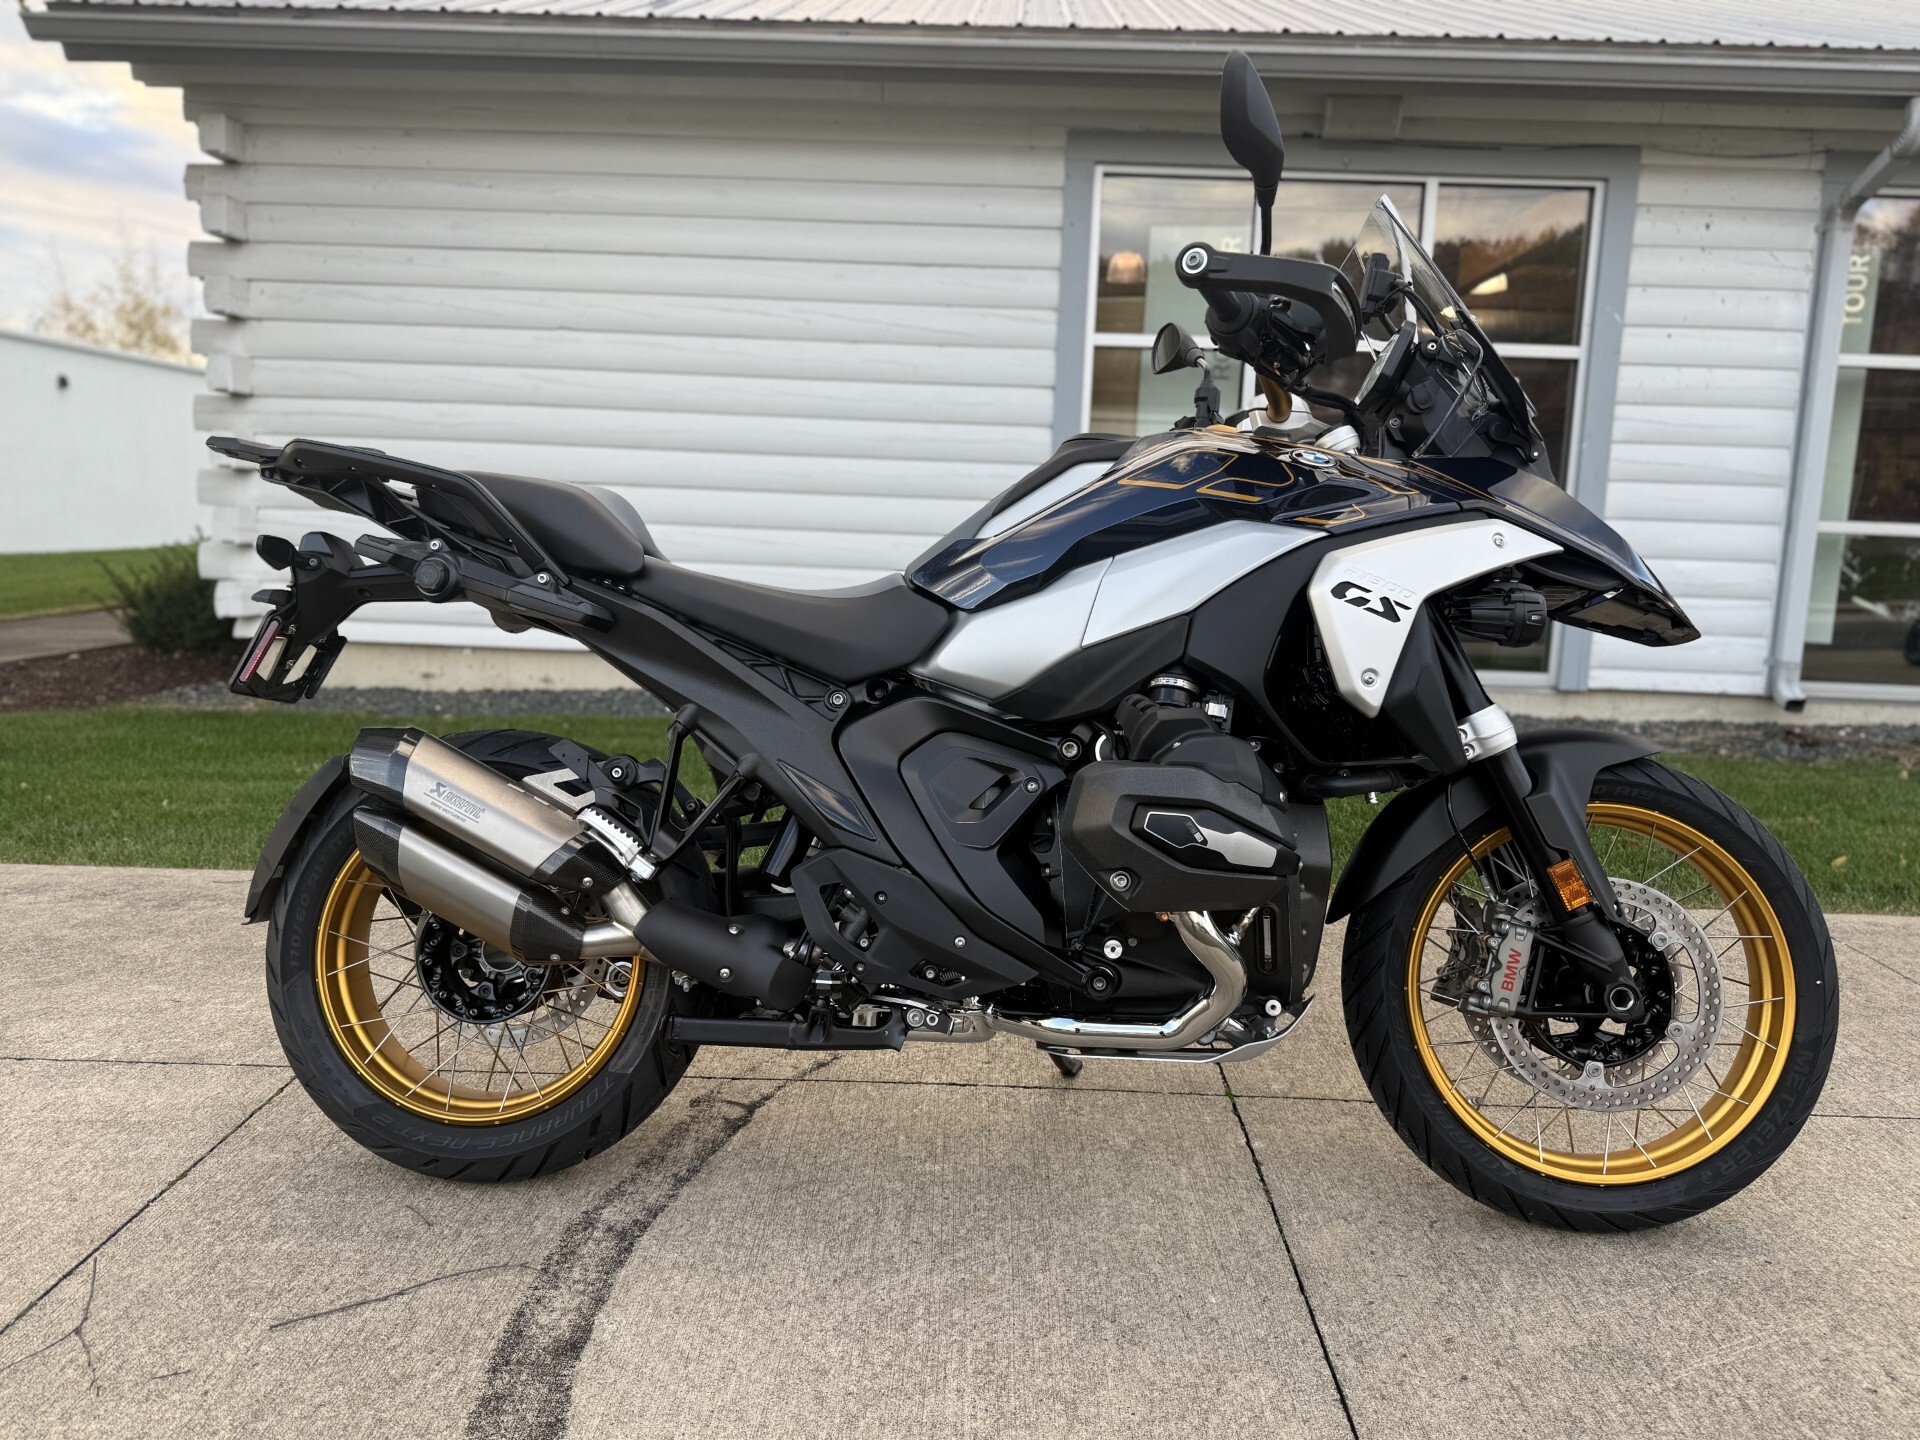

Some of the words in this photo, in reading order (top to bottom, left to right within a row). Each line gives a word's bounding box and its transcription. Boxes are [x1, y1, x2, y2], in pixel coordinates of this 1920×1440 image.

[1330, 580, 1413, 623] GS
[289, 895, 311, 967] 170/60
[1500, 947, 1522, 992] BMW
[477, 1075, 615, 1151] TOURANCE
[1719, 1048, 1815, 1176] METZELER
